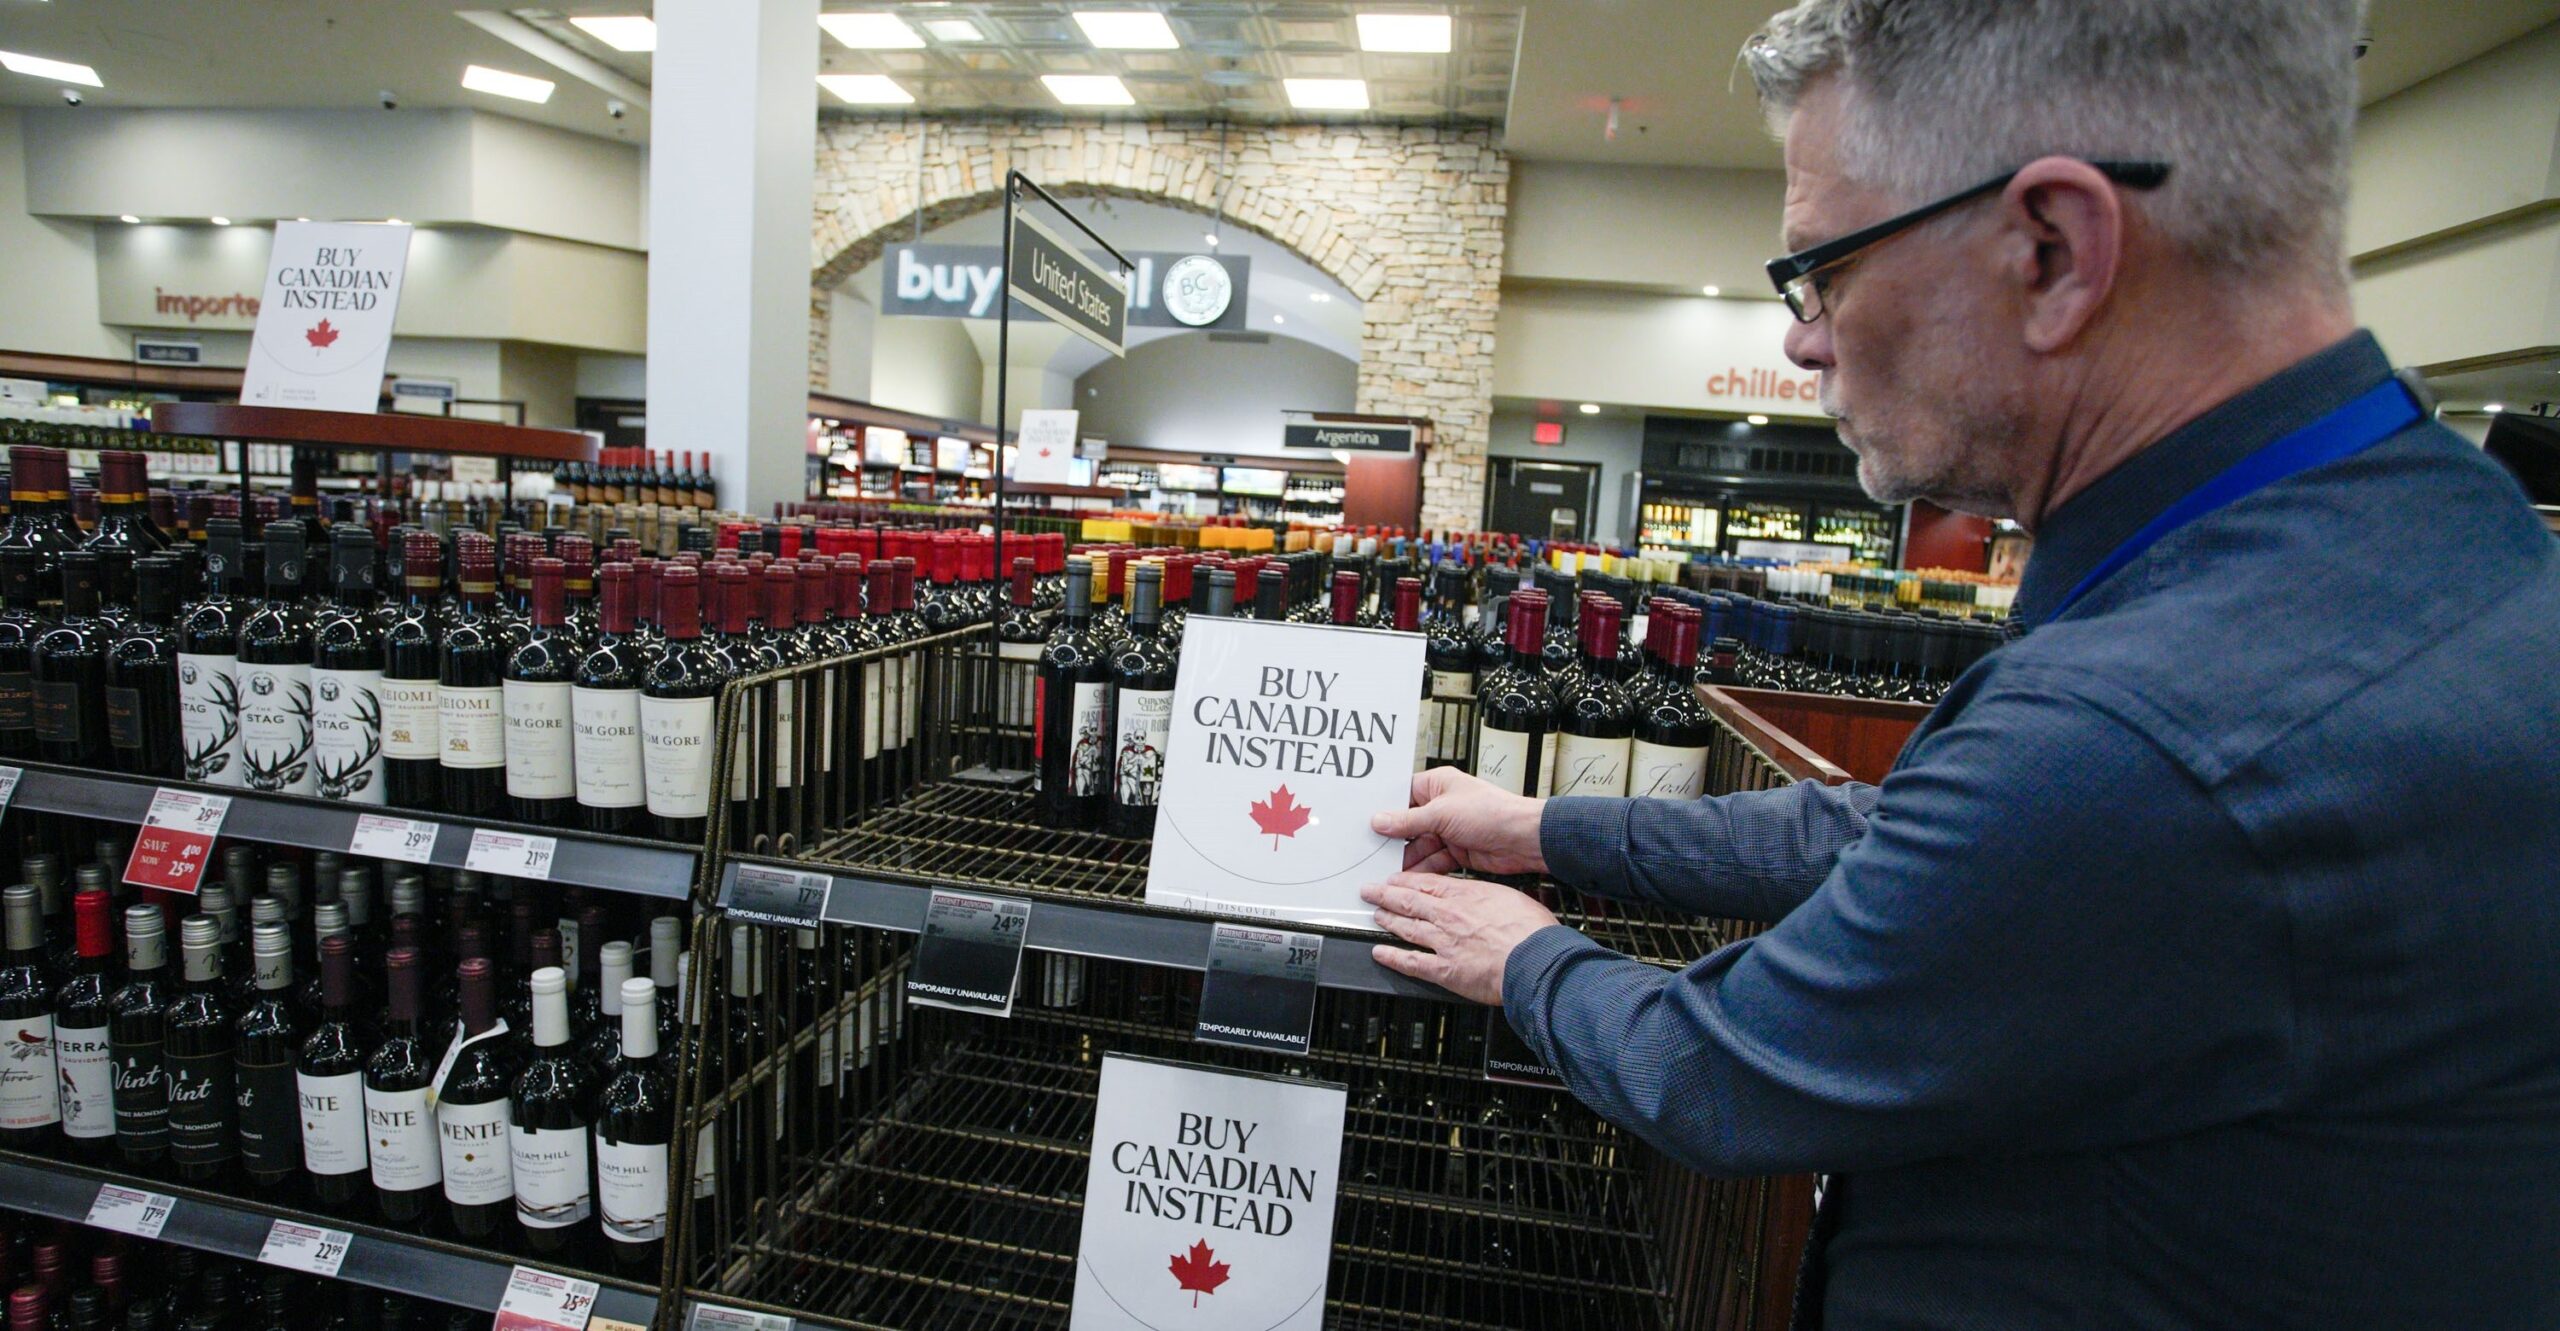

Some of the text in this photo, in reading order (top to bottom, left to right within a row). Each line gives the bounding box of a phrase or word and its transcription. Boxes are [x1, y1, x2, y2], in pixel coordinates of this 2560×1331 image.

[316, 248, 362, 267] BUY
[277, 267, 393, 289] CANADIAN
[896, 248, 1002, 317] buy
[1032, 247, 1077, 305] United
[1077, 279, 1111, 327] States
[1180, 272, 1209, 296] BC
[155, 286, 261, 322] importe
[283, 290, 377, 311] INSTEAD
[1707, 367, 1820, 402] chilled
[1314, 429, 1380, 448] Argentina
[1258, 665, 1339, 702] BUY
[246, 713, 285, 724] STAG
[316, 720, 350, 730] STAG
[525, 718, 563, 729] GORE
[1124, 717, 1148, 731] PASO
[1193, 695, 1398, 745] CANADIAN
[597, 725, 635, 737] GORE
[662, 736, 701, 746] GORE
[1205, 732, 1375, 779] INSTEAD
[1558, 754, 1618, 796] Josh
[1645, 763, 1699, 798] Josh
[142, 839, 170, 853] SAVE
[140, 855, 160, 865] NOW
[934, 895, 993, 912] CABERNET SAUVIGNON
[1217, 903, 1277, 916] DISCOVER
[727, 908, 819, 928] TEMPORARILY UNAVAILABLE
[1217, 928, 1282, 944] CABERNET SAUVIGNON
[907, 981, 1007, 1003] TEMPORARILY UNAVAILABLE
[1199, 1022, 1306, 1044] TEMPORARILY UNAVAILABLE
[57, 1040, 109, 1053] TERRA
[111, 1061, 162, 1090] Vint
[1489, 1060, 1545, 1075] TEMPORARILY
[165, 1072, 213, 1101] Vint
[238, 1088, 254, 1107] nt
[300, 1092, 340, 1111] ENTE
[133, 1109, 168, 1118] MONDAV
[442, 1120, 504, 1141] WENTE
[1177, 1112, 1258, 1155] BUY
[543, 1151, 570, 1161] HILL
[622, 1165, 649, 1174] HILL
[1111, 1141, 1317, 1203] CANADIAN
[1125, 1180, 1293, 1238] INSTEAD
